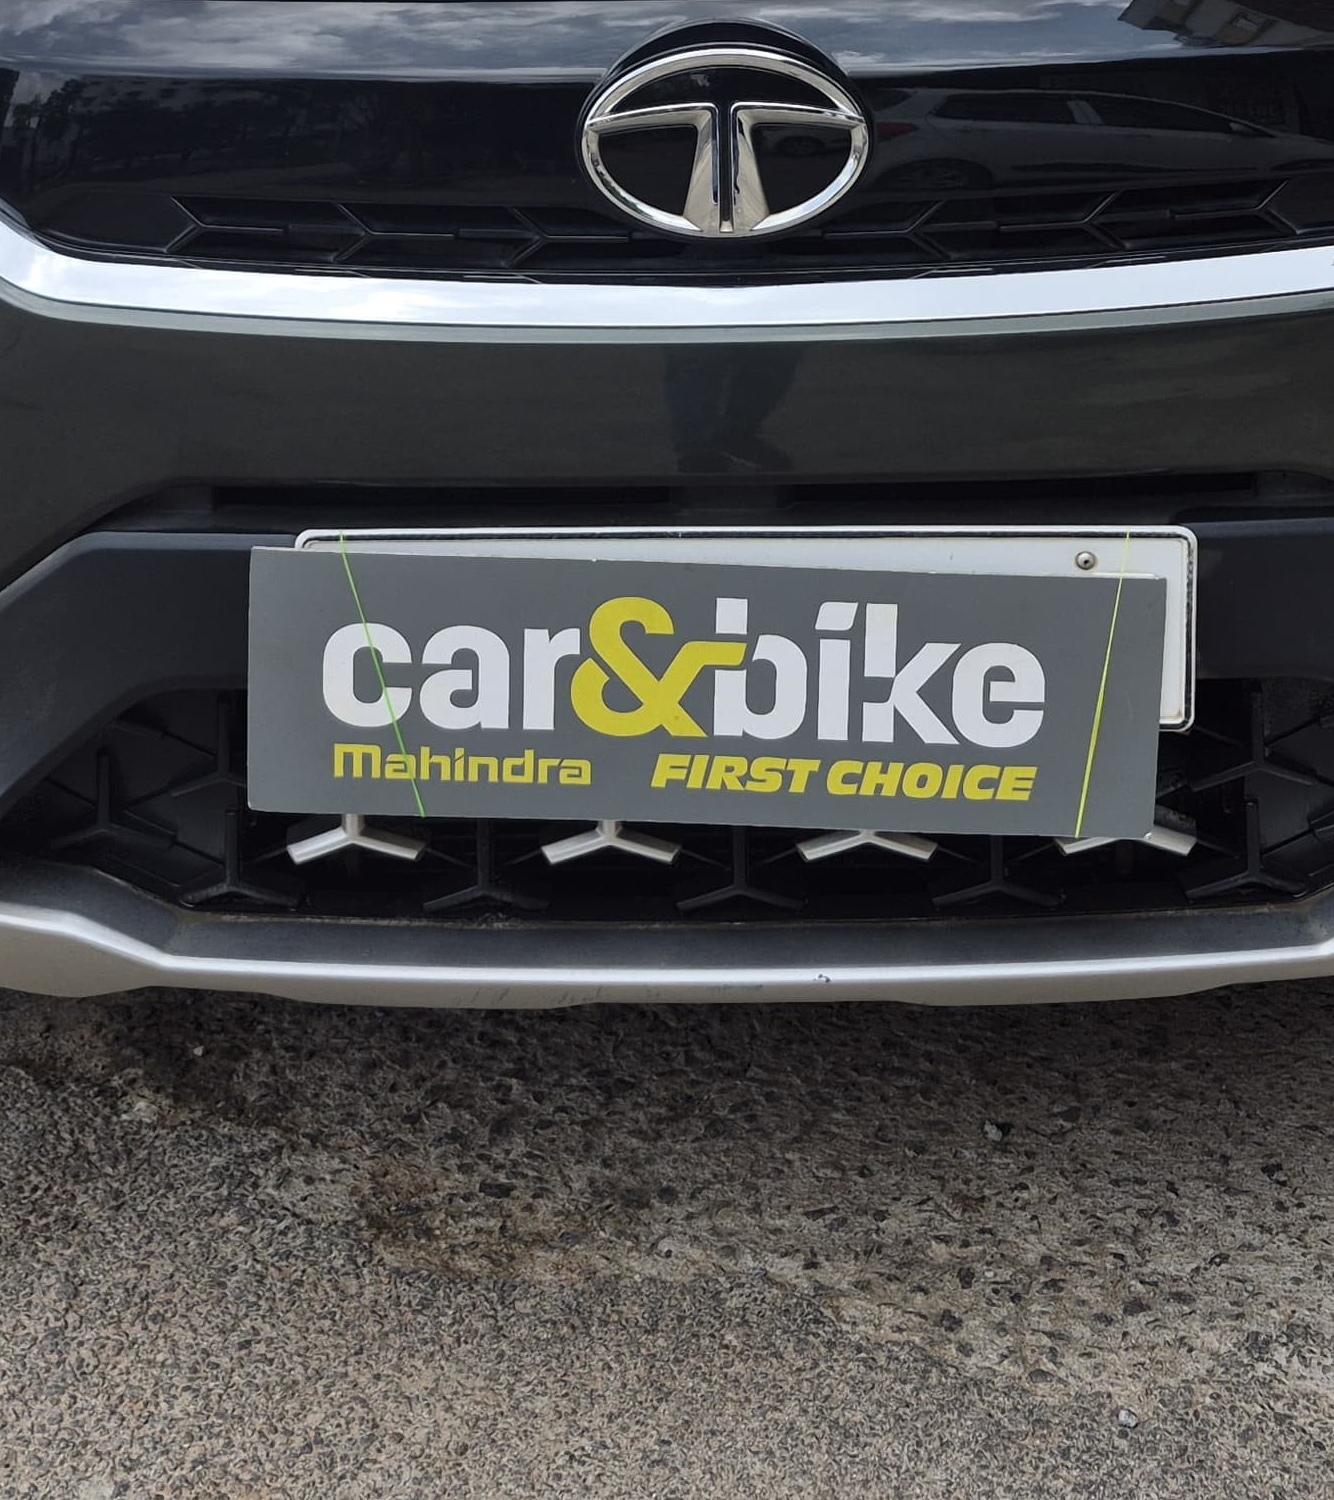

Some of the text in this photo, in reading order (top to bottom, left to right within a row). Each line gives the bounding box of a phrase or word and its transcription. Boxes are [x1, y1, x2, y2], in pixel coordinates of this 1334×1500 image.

[323, 596, 1046, 748] car&bike
[333, 743, 1038, 801] Mahindra FIRST CHOICE
